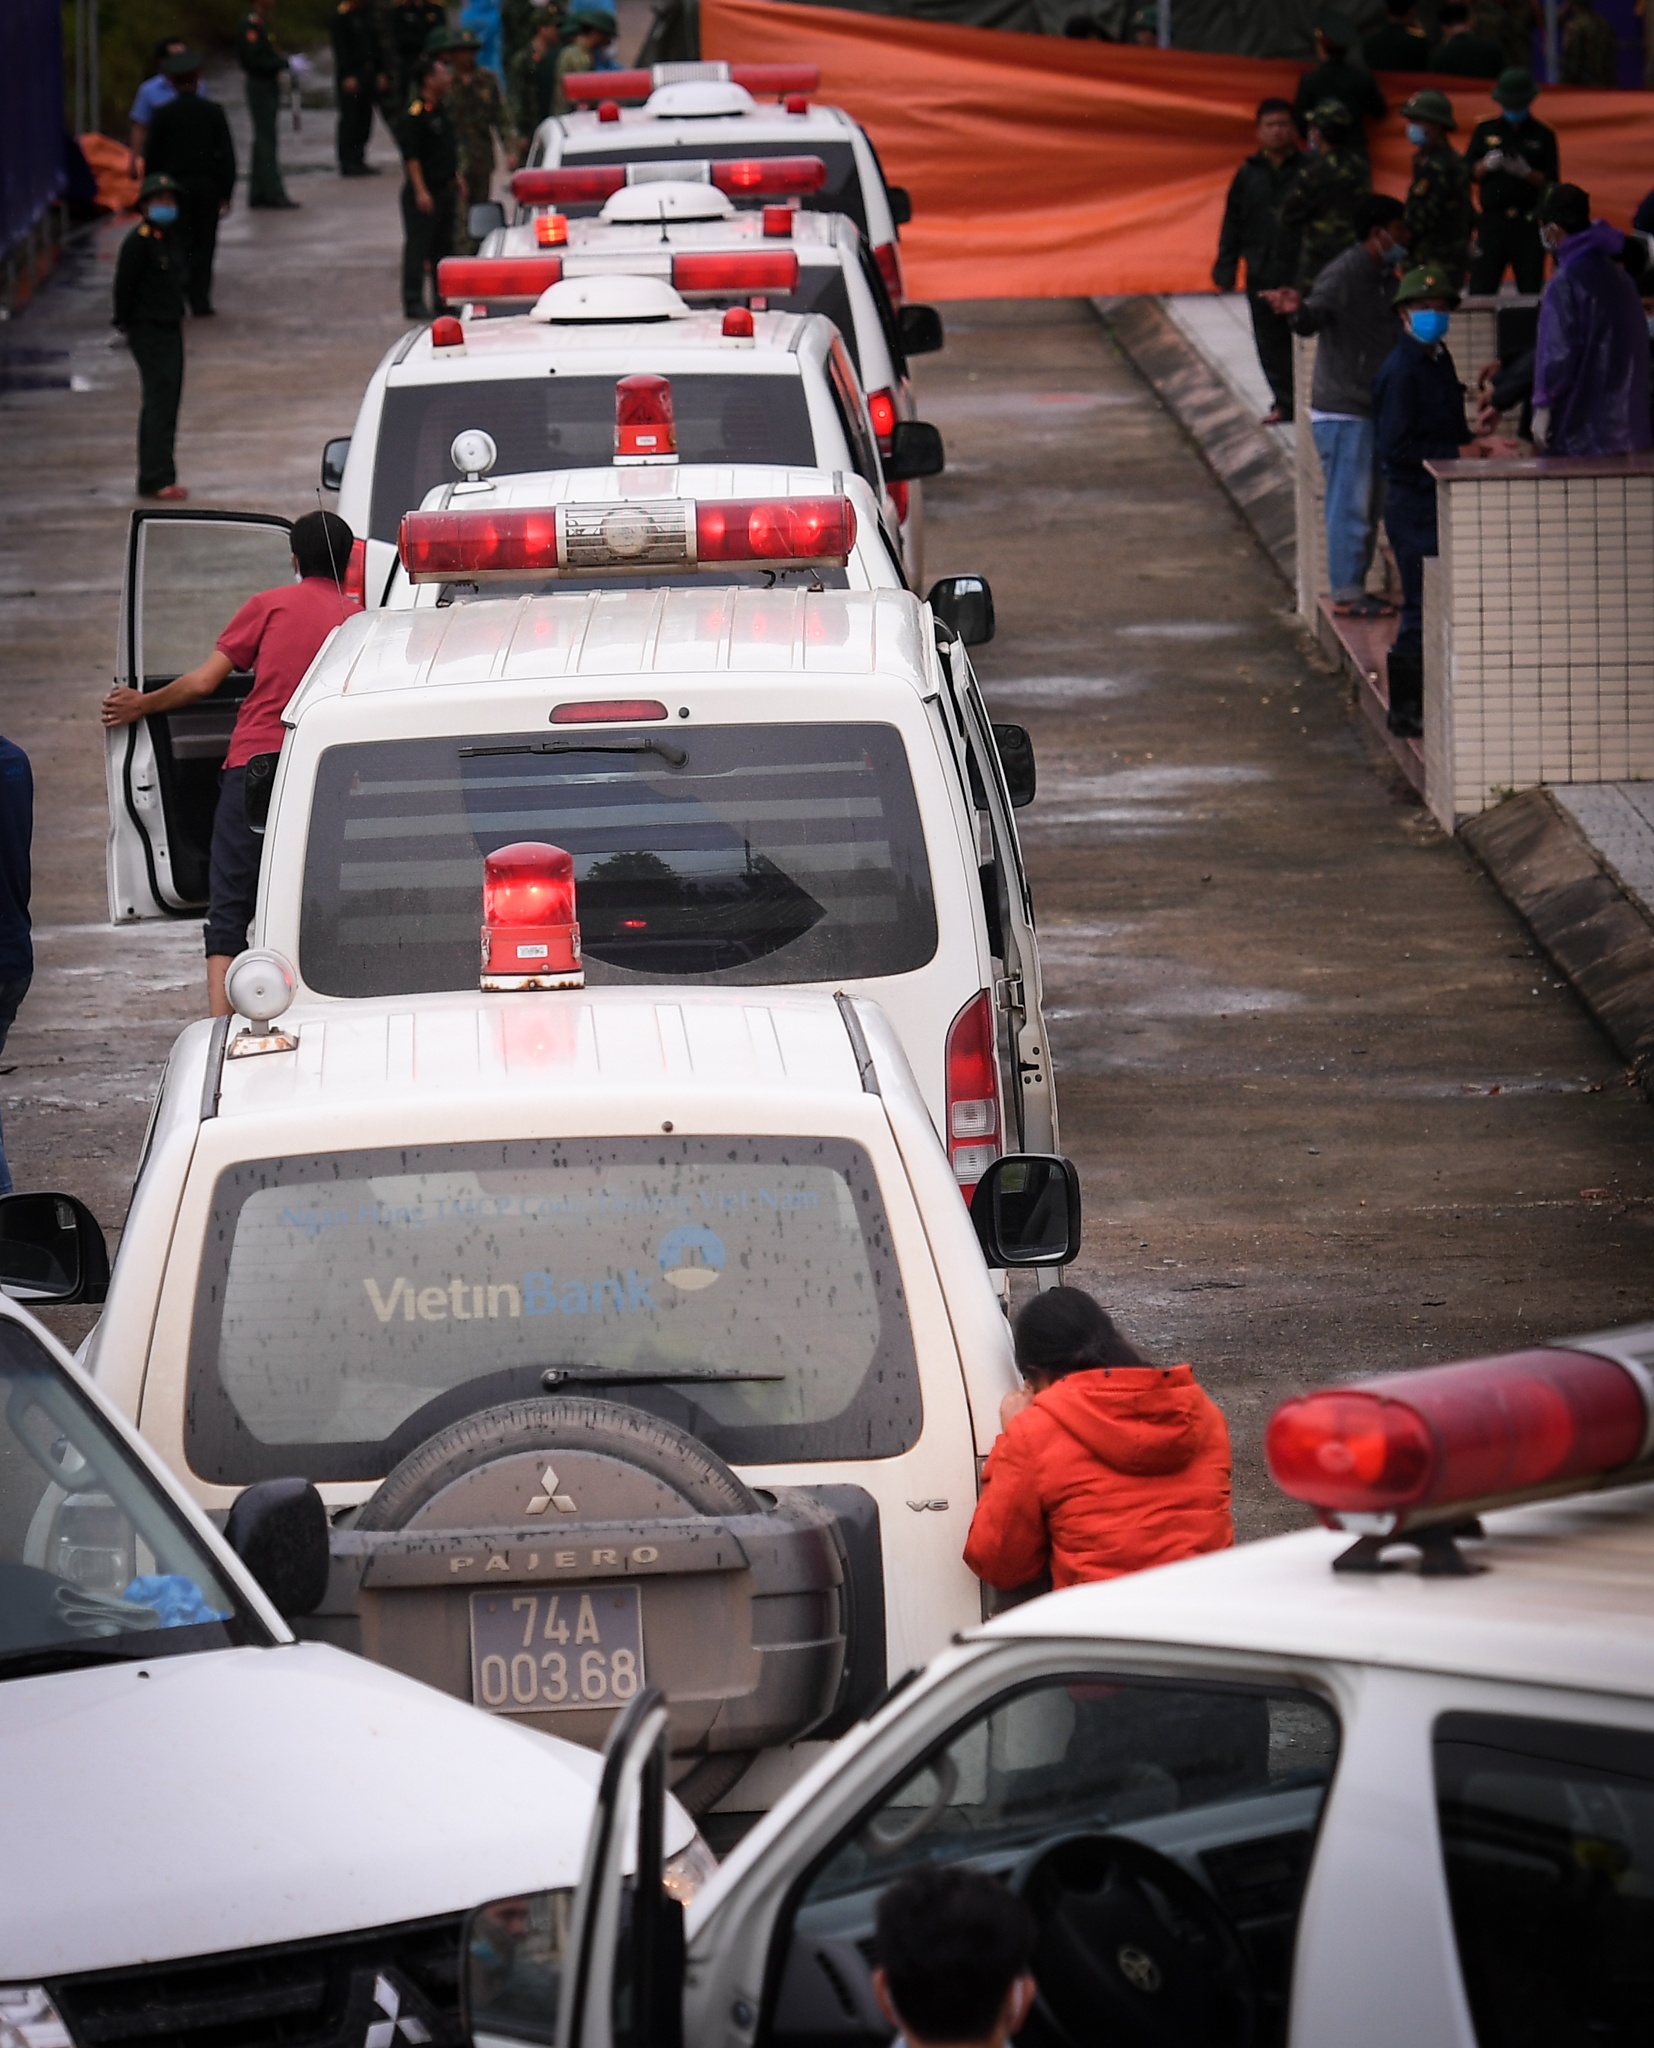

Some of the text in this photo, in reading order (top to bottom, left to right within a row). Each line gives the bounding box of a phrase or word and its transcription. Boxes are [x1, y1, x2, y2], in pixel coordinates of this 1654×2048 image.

[364, 1270, 657, 1322] VietinBank
[906, 1499, 949, 1512] V6
[450, 1546, 659, 1573] PAJERO
[512, 1594, 600, 1648] 74A
[481, 1648, 638, 1706] 003.68
